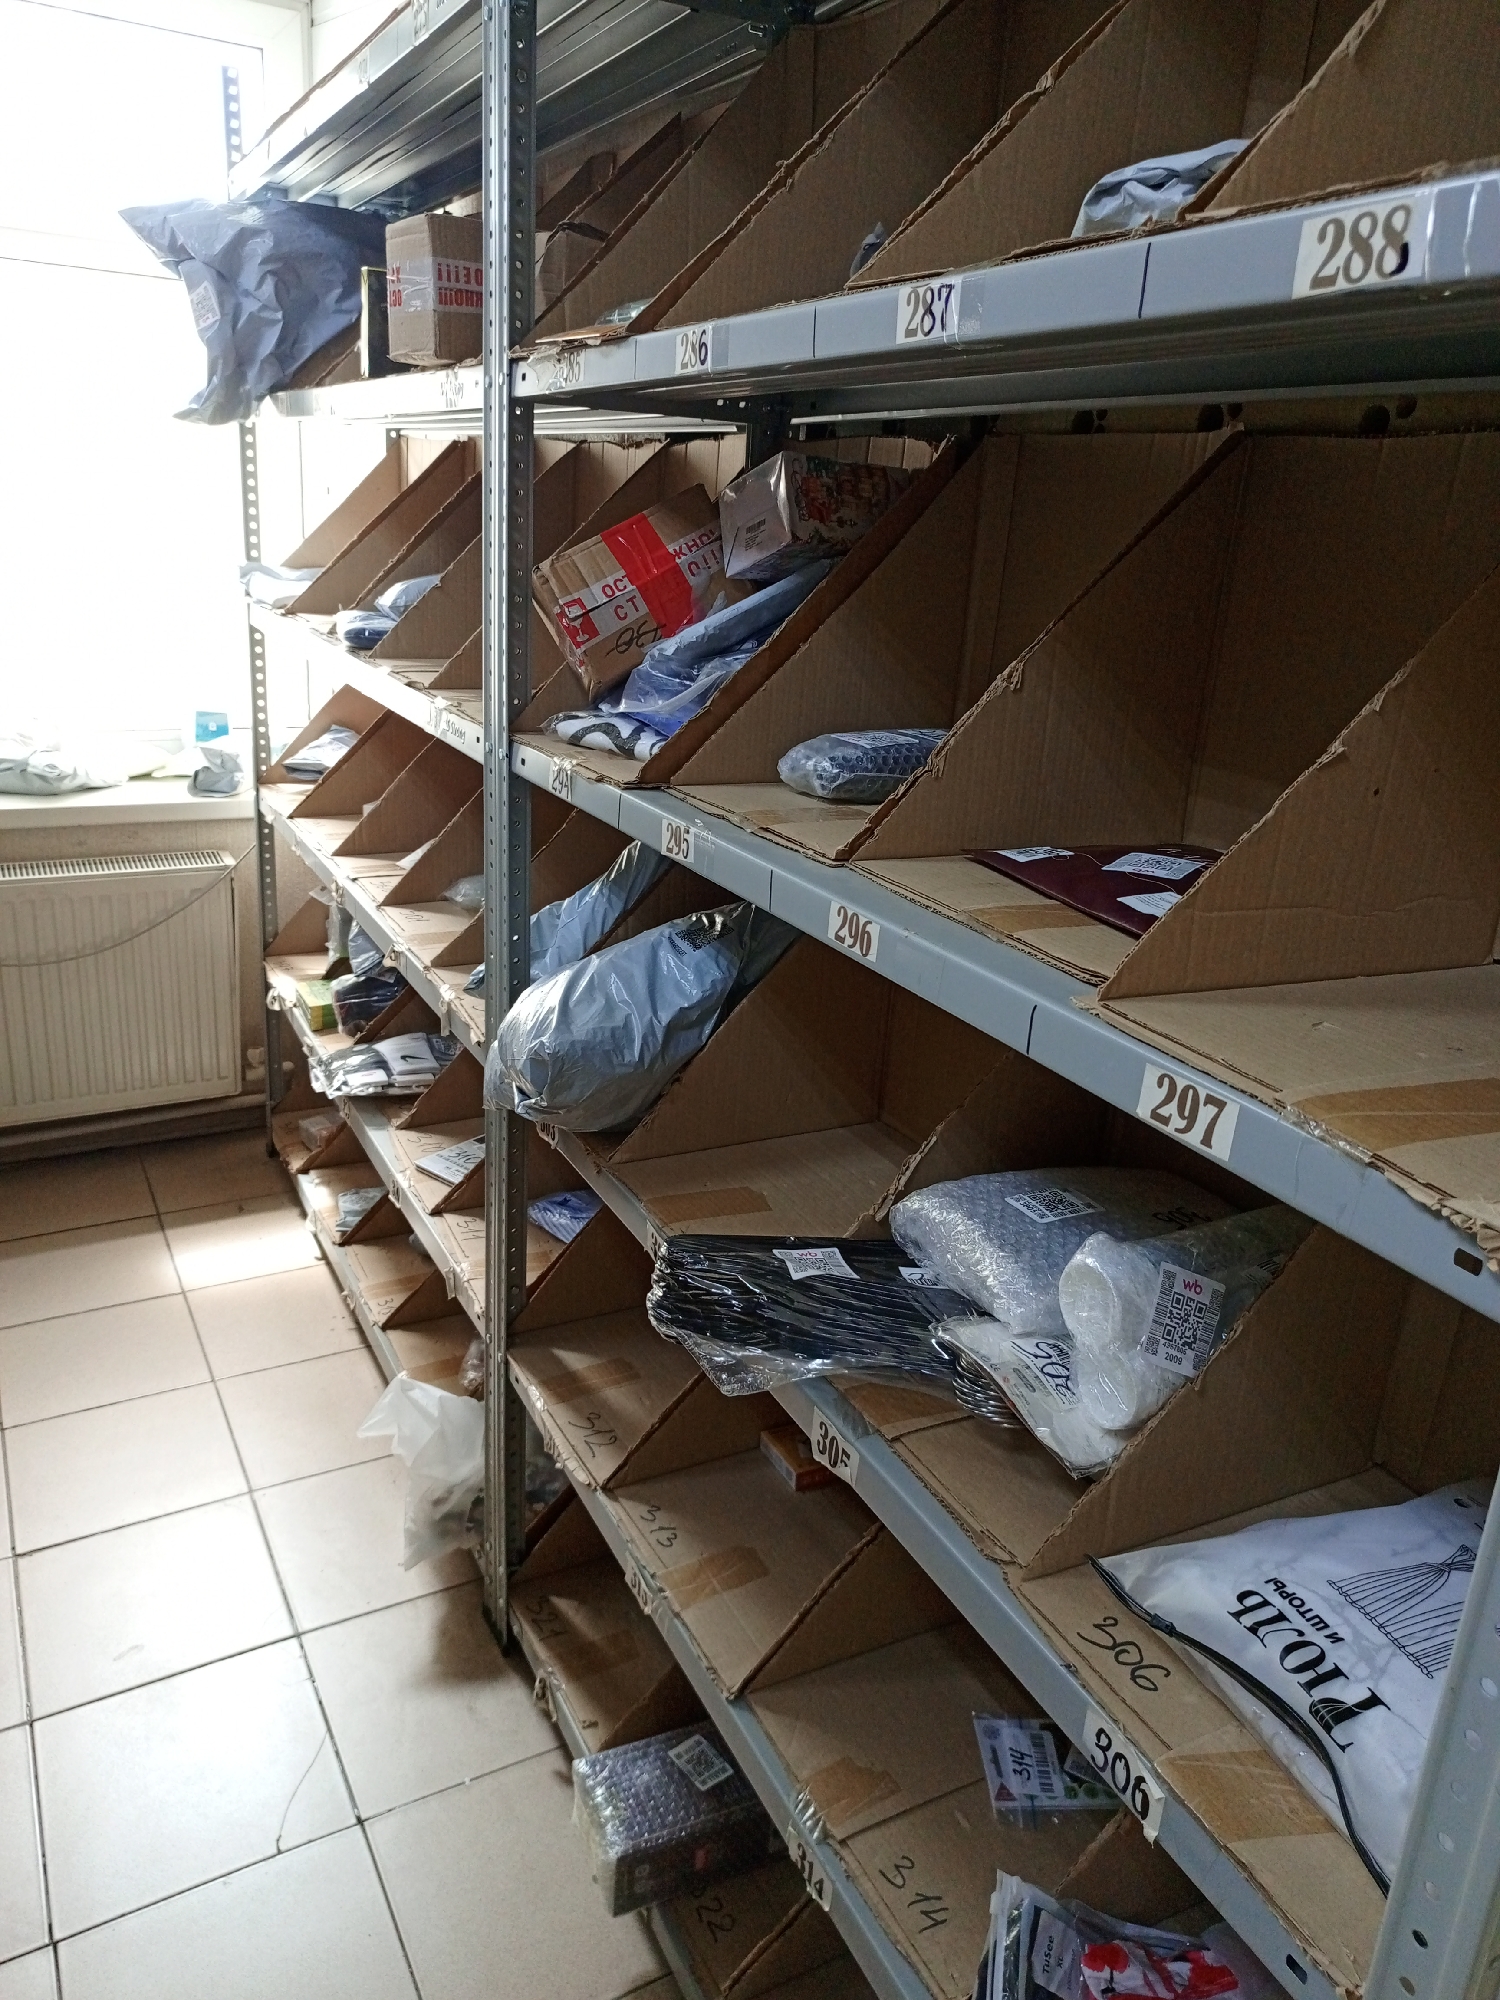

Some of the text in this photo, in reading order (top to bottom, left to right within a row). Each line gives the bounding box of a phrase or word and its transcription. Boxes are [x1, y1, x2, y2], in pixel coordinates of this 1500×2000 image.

[1309, 203, 1411, 291] 288
[904, 284, 956, 339] 287
[680, 329, 709, 370] 286
[666, 822, 691, 860] 295
[835, 905, 873, 958] 296
[1149, 1073, 1228, 1150] 297
[1183, 1278, 1204, 1296] wb
[1164, 1351, 1184, 1366] 2009
[639, 1504, 679, 1548] 313
[1264, 1577, 1331, 1632] ШТОРЫ
[1076, 1616, 1172, 1692] 306
[1226, 1589, 1392, 1754] ТЮЛЬ
[1009, 1746, 1034, 1781] 314
[1090, 1727, 1151, 1821] 306
[878, 1854, 950, 1934] 314
